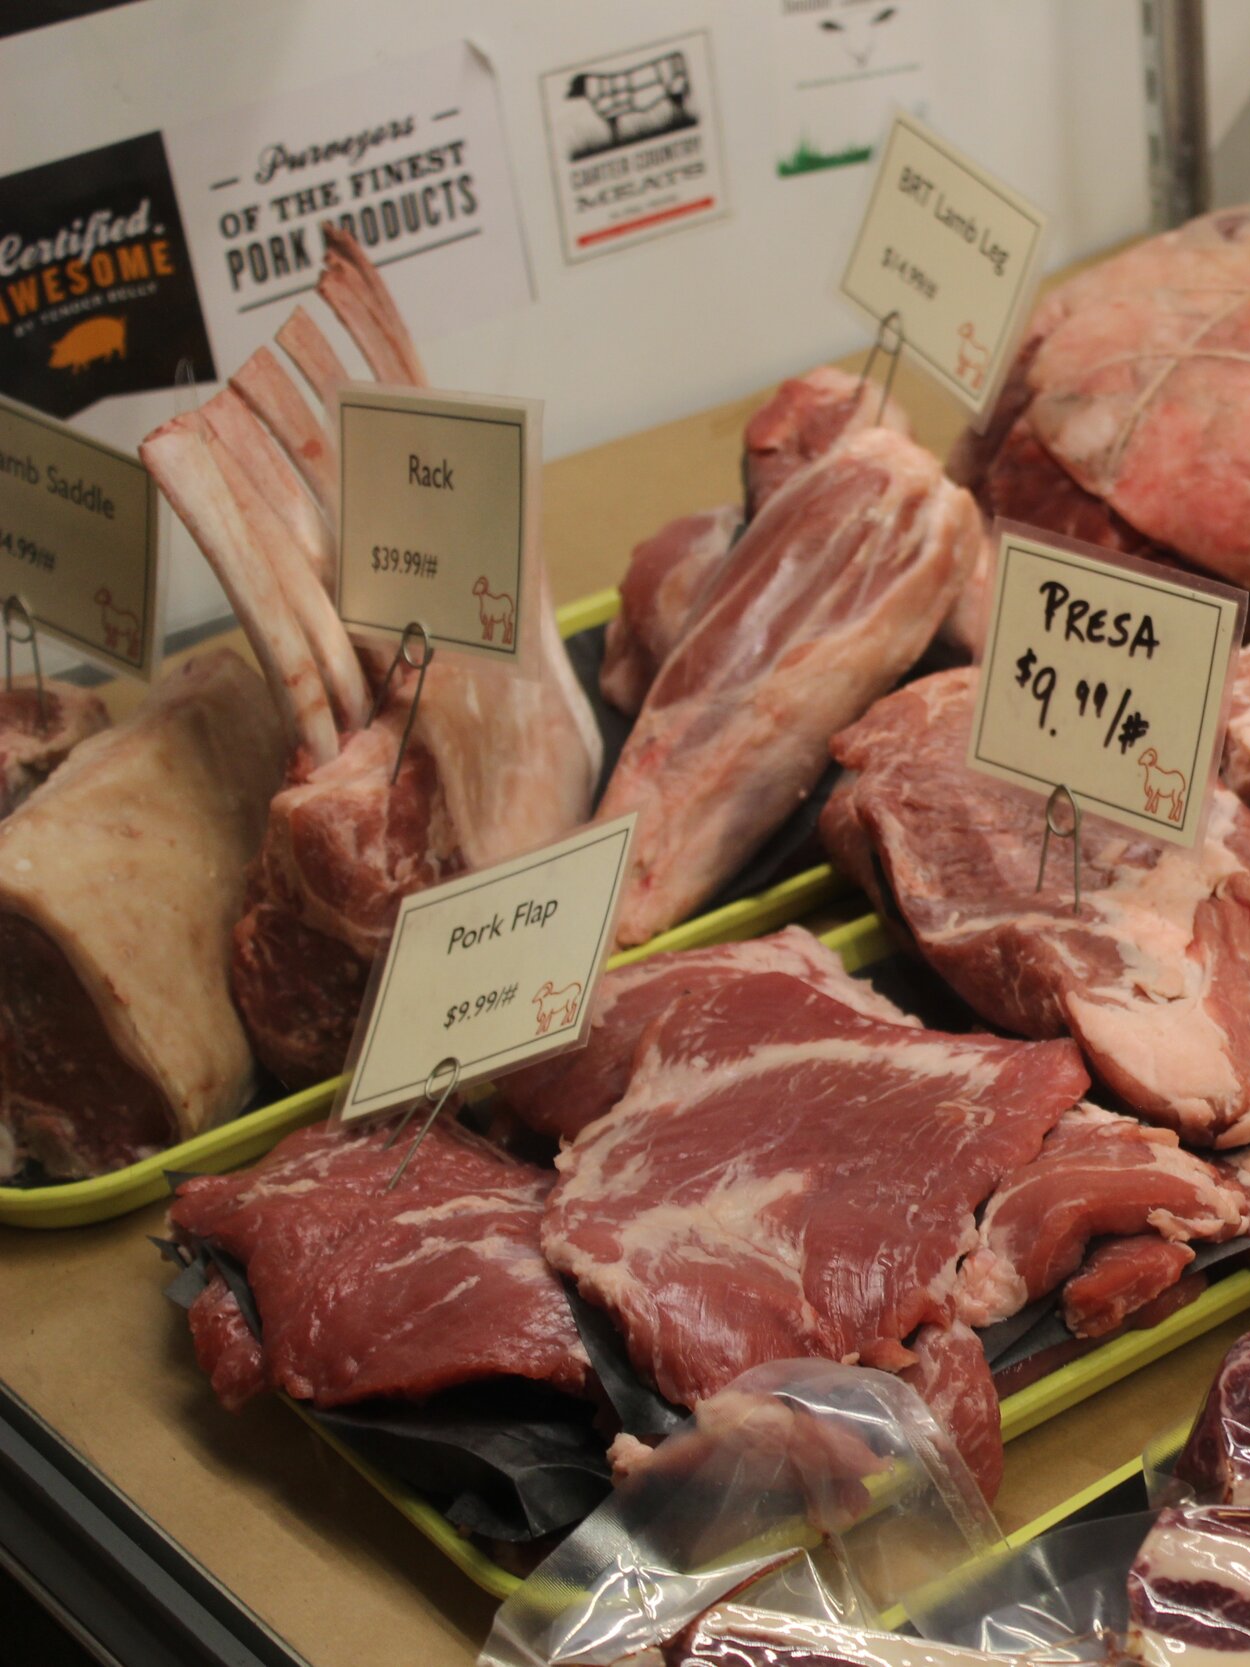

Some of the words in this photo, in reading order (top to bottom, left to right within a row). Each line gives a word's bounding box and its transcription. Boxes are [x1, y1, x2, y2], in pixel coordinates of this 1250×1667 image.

[254, 115, 416, 185] Purveyors
[219, 205, 259, 240] OF
[270, 181, 340, 223] THE
[347, 140, 466, 199] FINEST
[576, 161, 706, 213] MEATS
[225, 226, 312, 292] PORK
[933, 192, 978, 245] Lamb
[979, 228, 1010, 278] Leg
[46, 463, 116, 520] Saddle
[409, 453, 455, 491] Rack
[371, 545, 438, 579] $39.99/#
[1039, 580, 1161, 660] PRESA
[447, 912, 504, 956] Pork
[511, 898, 559, 932] Flap
[443, 982, 519, 1031] $9.99/#
